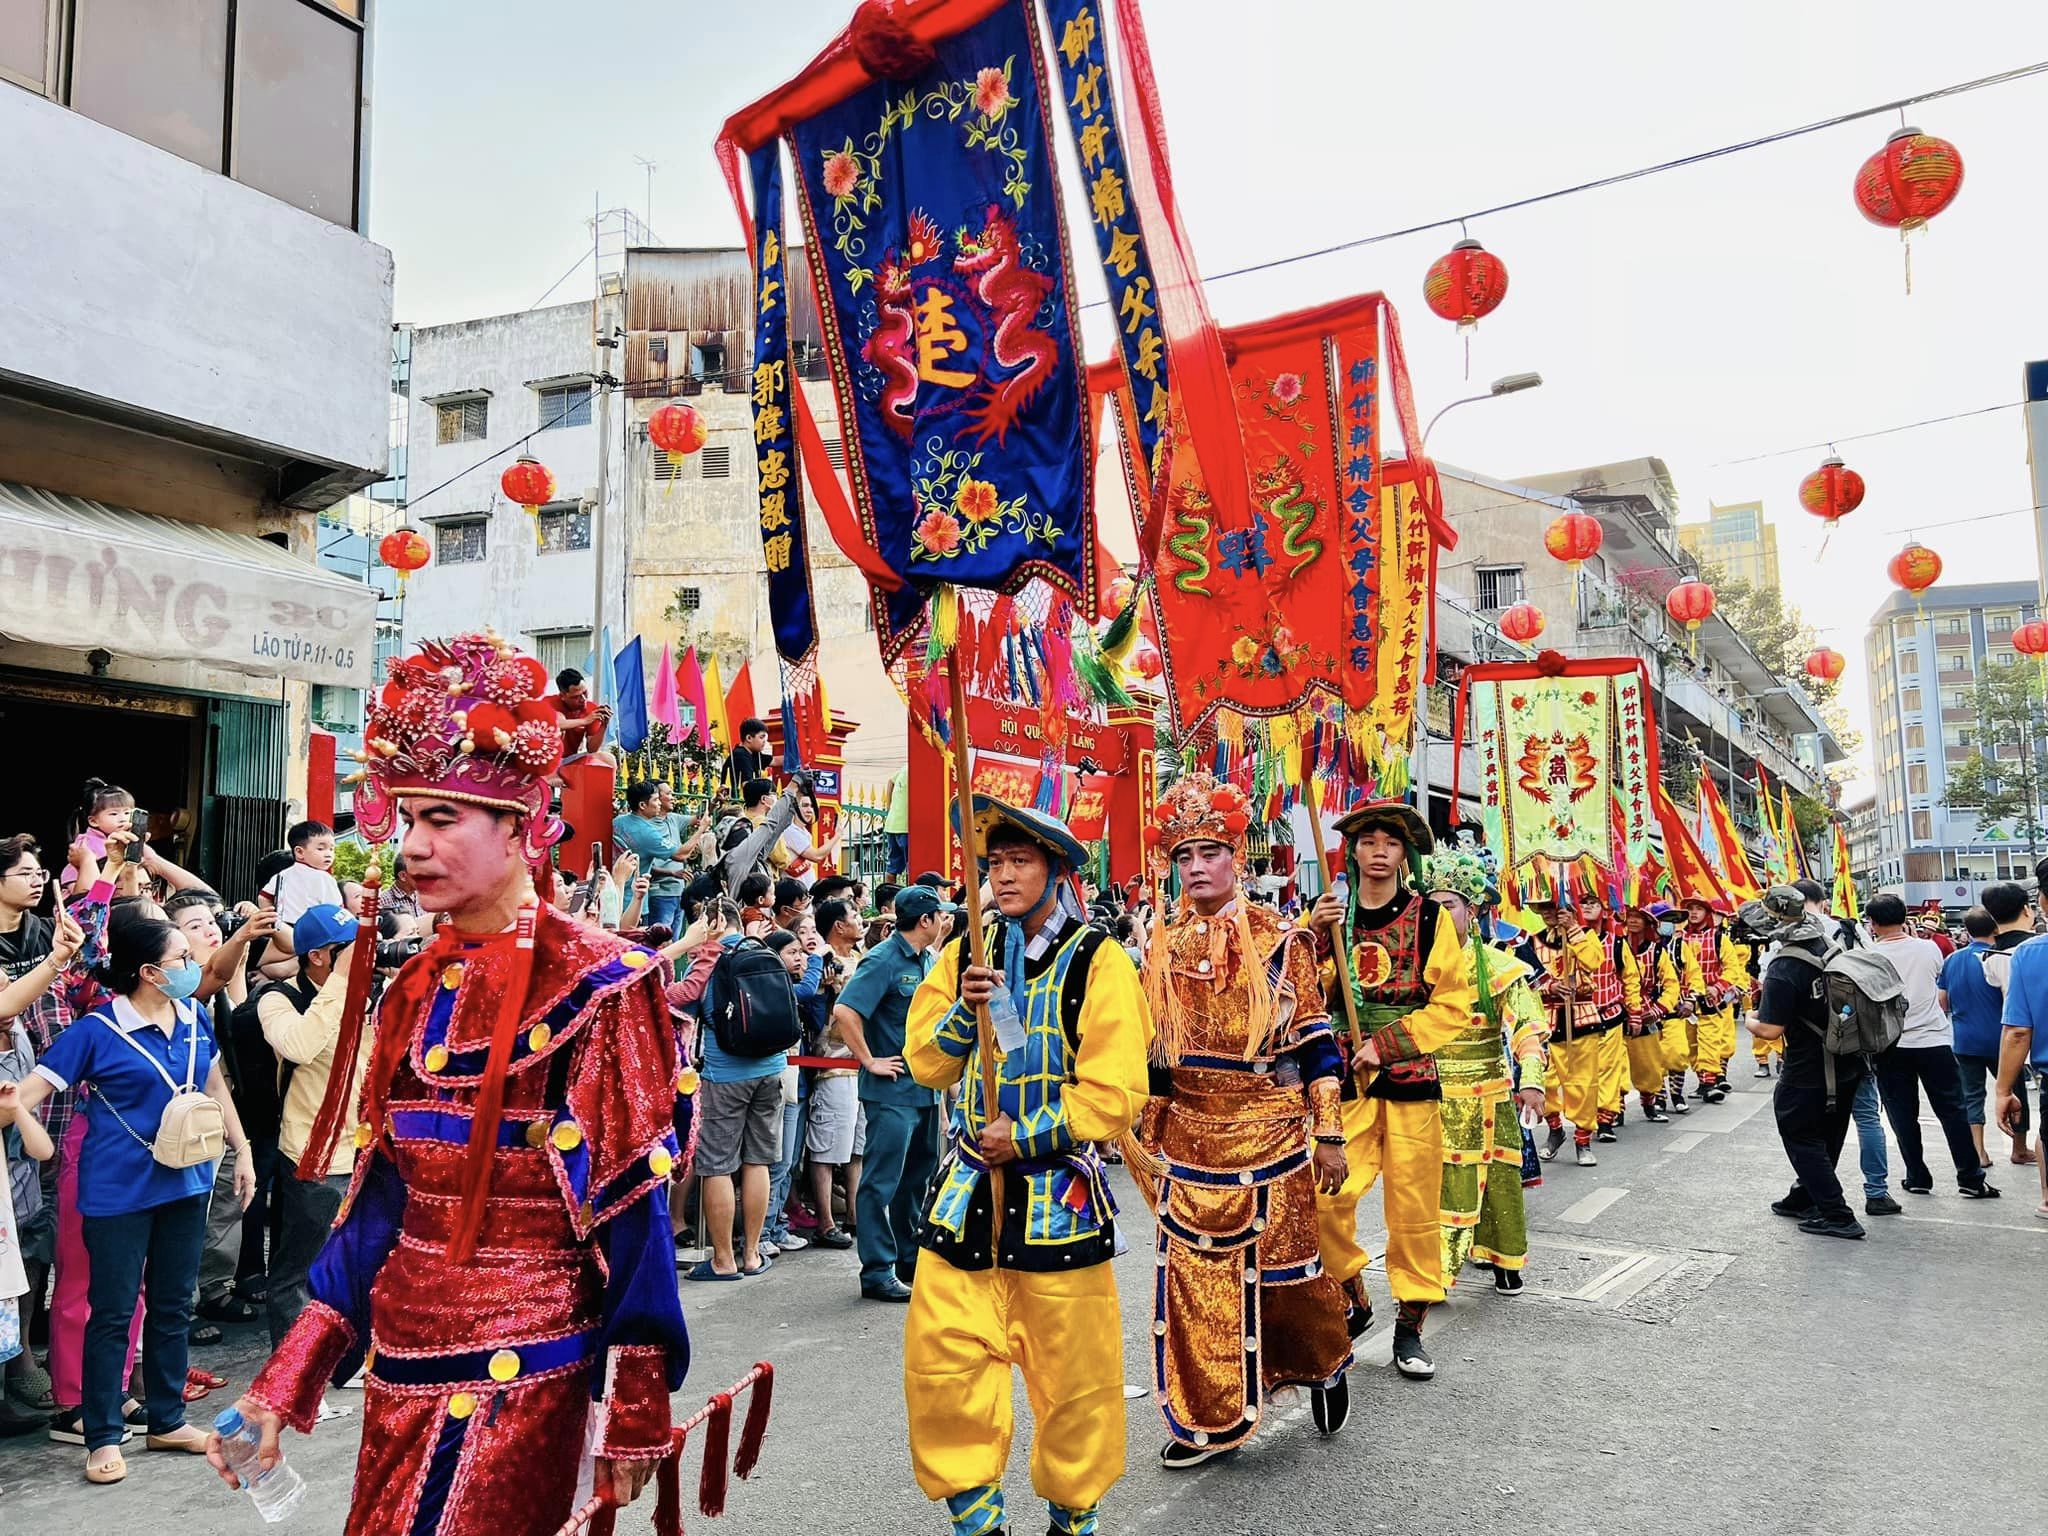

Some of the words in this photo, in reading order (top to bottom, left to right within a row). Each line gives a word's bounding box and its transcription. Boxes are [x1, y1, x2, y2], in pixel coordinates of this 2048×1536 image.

[253, 631, 280, 657] LÃO
[283, 633, 301, 660] TỬ
[303, 643, 328, 665] P.11
[335, 647, 354, 669] Q.5
[1001, 716, 1018, 738] HỘI
